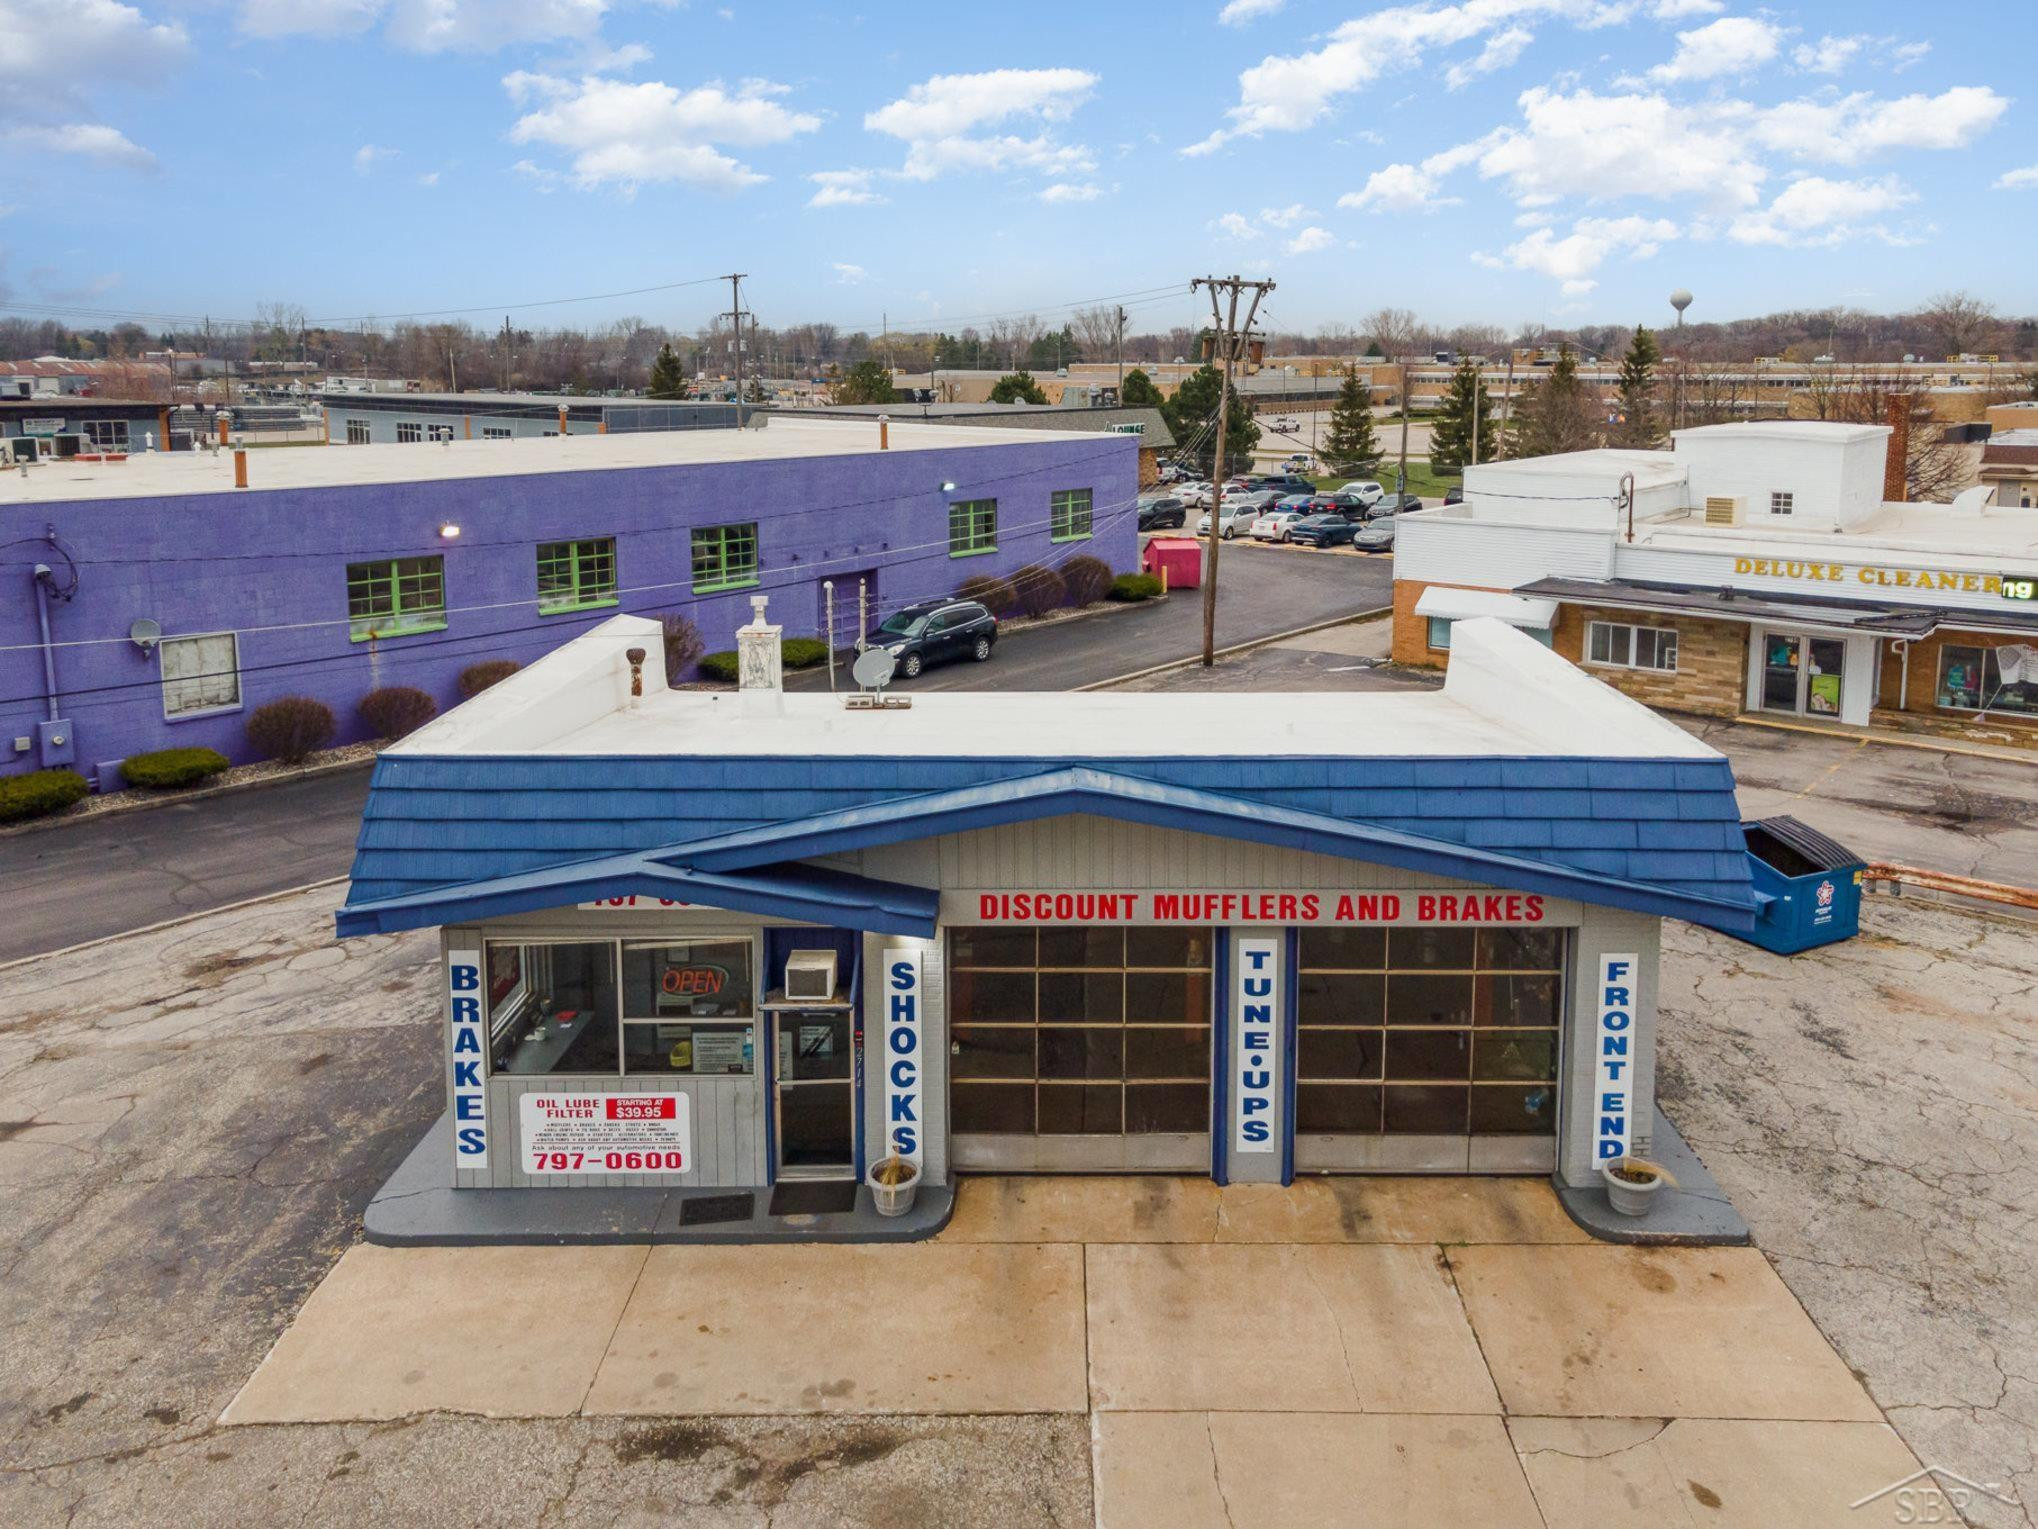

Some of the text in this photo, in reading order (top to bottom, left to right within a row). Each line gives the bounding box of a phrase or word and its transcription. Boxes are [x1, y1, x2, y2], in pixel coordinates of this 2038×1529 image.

[1735, 558, 1845, 582] DELUXE
[980, 893, 1545, 923] DISCOUNT MUFFLERS AND BRAKES
[662, 968, 725, 994] OPEN
[451, 965, 486, 1155] BRAKES
[889, 962, 917, 1155] SHOCKS
[1598, 962, 1630, 1160] FRONT END
[536, 1098, 600, 1108] OIL LUBE
[547, 1109, 593, 1118] FILTER
[616, 1098, 653, 1106] STARTING
[616, 1106, 662, 1118] $39.95
[533, 1152, 682, 1170] 797-0600
